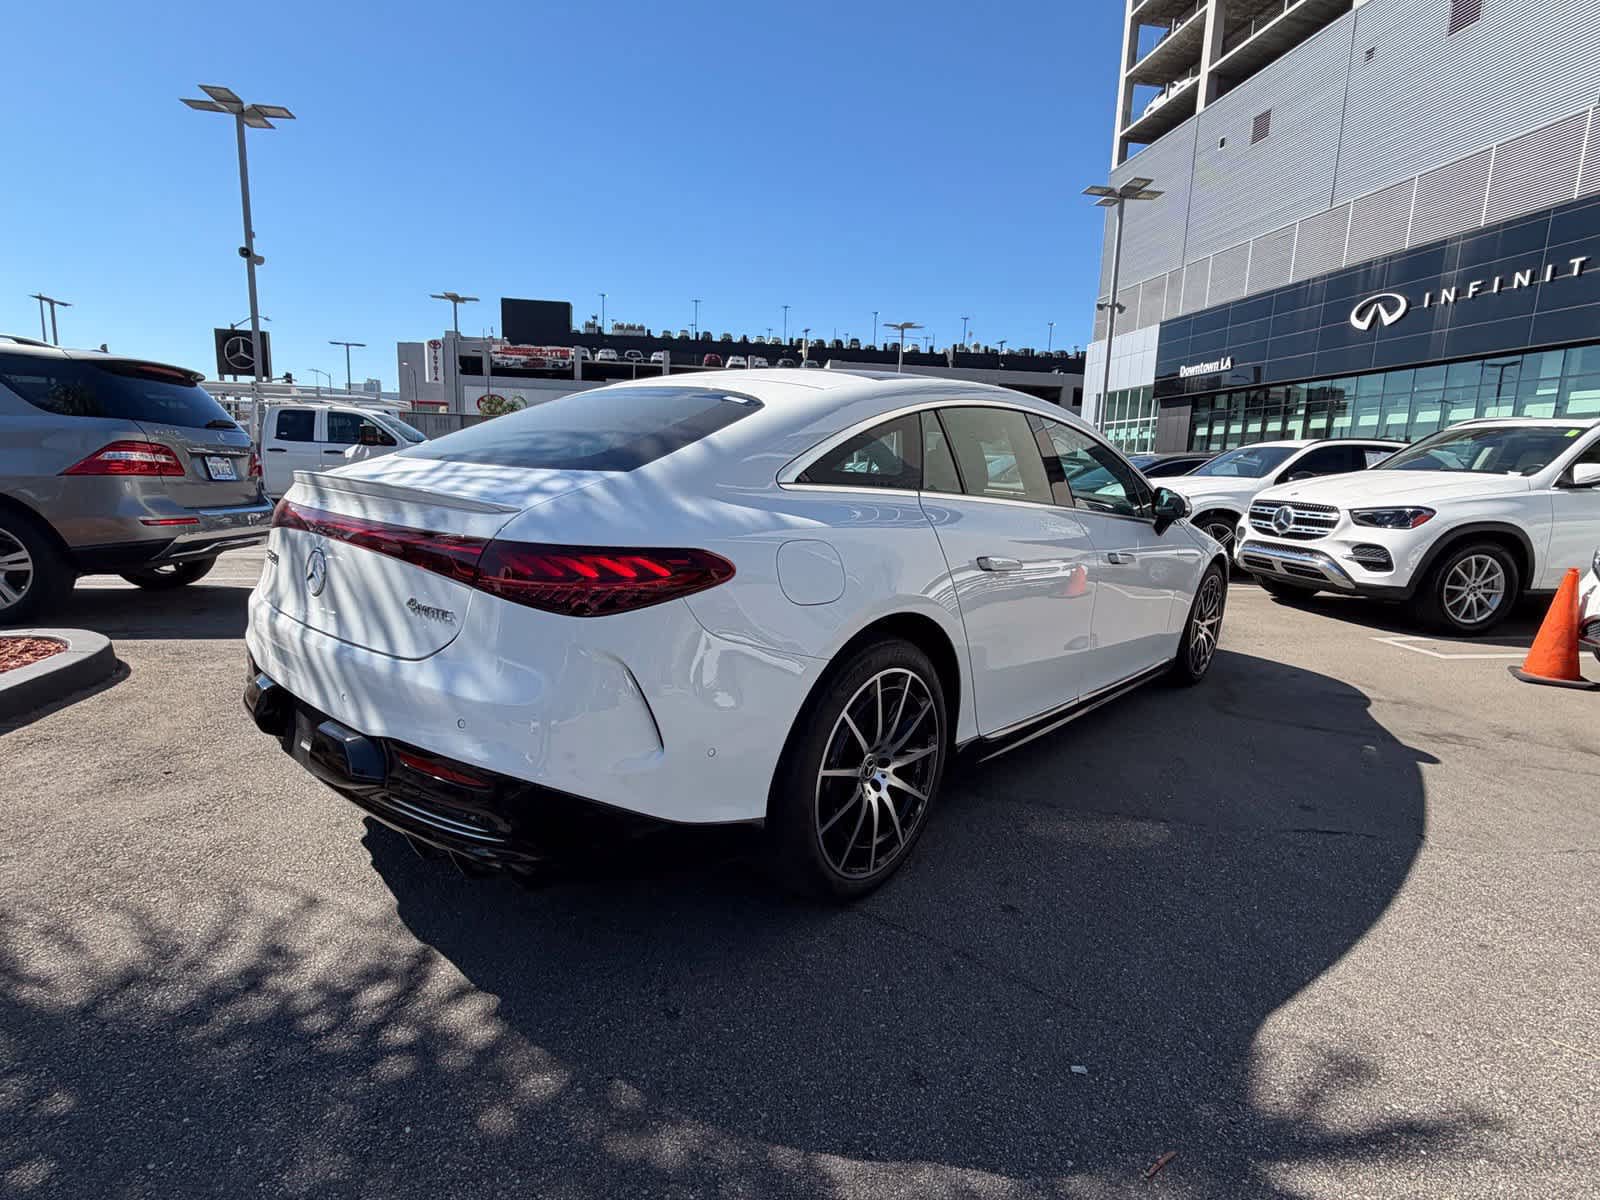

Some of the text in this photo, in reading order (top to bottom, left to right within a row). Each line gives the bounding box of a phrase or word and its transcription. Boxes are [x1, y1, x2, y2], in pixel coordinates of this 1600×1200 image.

[432, 350, 440, 382] TOYOTA
[1179, 356, 1232, 378] Downtown LA
